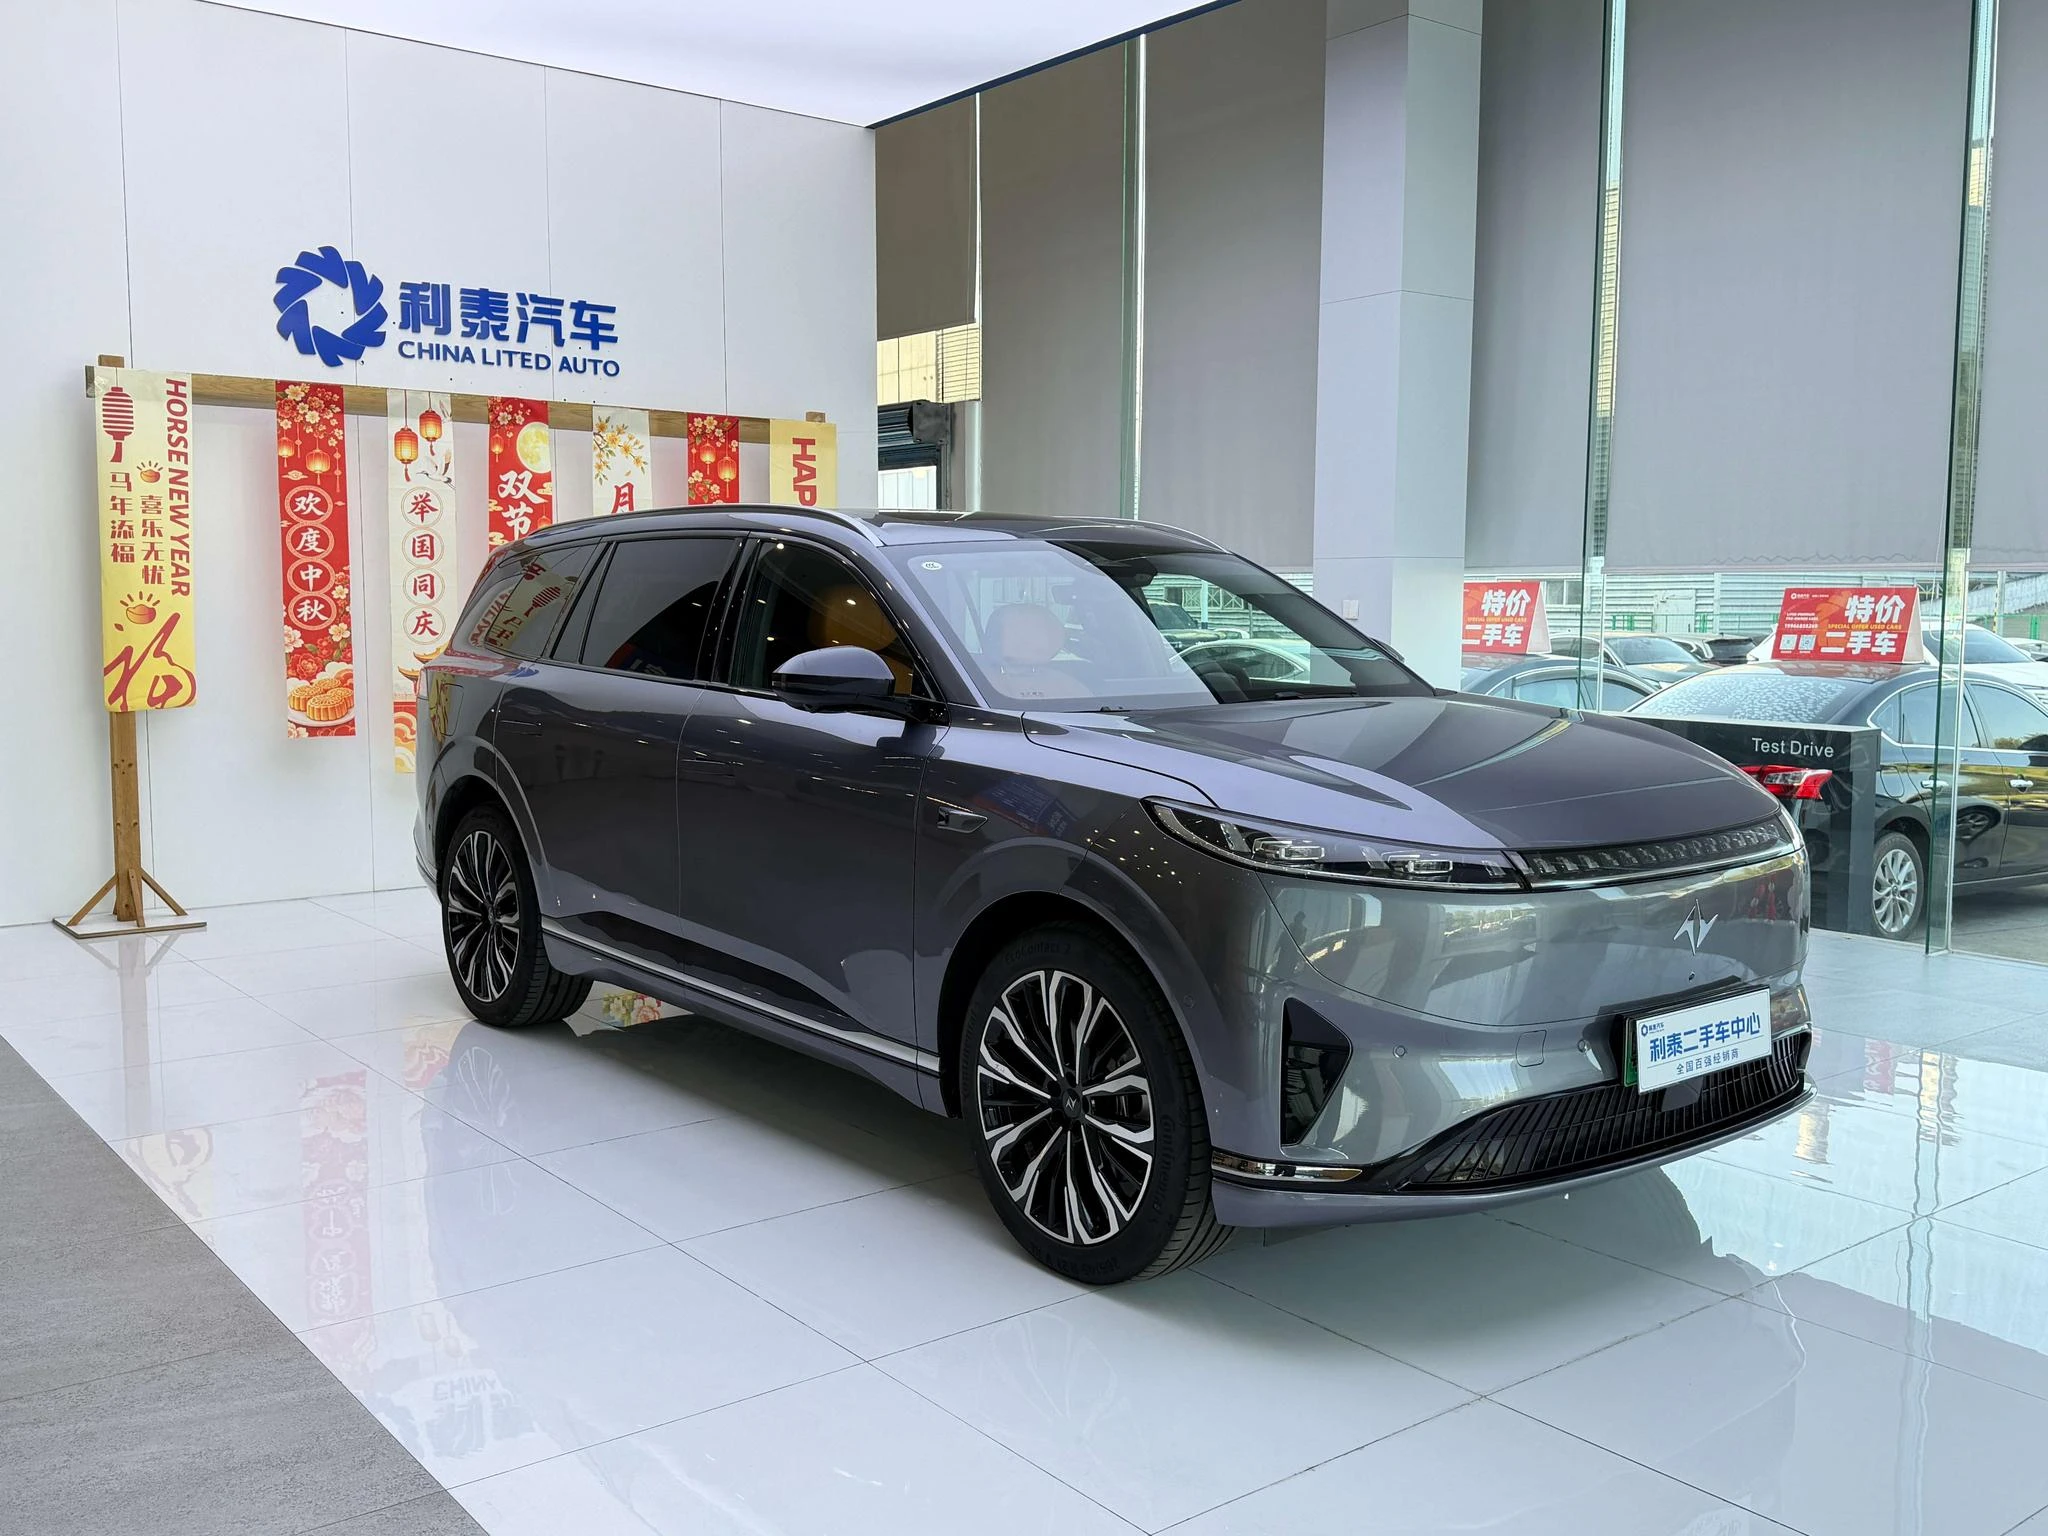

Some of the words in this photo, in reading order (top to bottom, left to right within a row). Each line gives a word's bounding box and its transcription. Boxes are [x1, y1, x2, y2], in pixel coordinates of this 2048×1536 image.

[398, 281, 619, 351] 利泰汽车
[398, 340, 476, 364] CHINA
[481, 347, 551, 371] LITED
[558, 355, 620, 377] AUTO
[165, 378, 189, 465] HORSE
[109, 471, 136, 563] 马年添福
[168, 467, 190, 529] NEW
[497, 470, 548, 541] 双节
[610, 482, 635, 514] 月
[140, 494, 165, 585] 喜乐无忧
[170, 533, 190, 597] YEAR
[293, 492, 330, 622] 欢度中秋
[407, 492, 440, 637] 举国同庆
[1481, 589, 1531, 617] 特价
[1844, 594, 1906, 623] 特价
[1462, 623, 1524, 647] 二手车
[1820, 630, 1898, 656] 二手车
[1751, 737, 1785, 754] Test
[1790, 740, 1834, 758] Drive
[1649, 1012, 1761, 1062] 利泰二手车中心
[1676, 1048, 1739, 1076] 全国百强经销商
